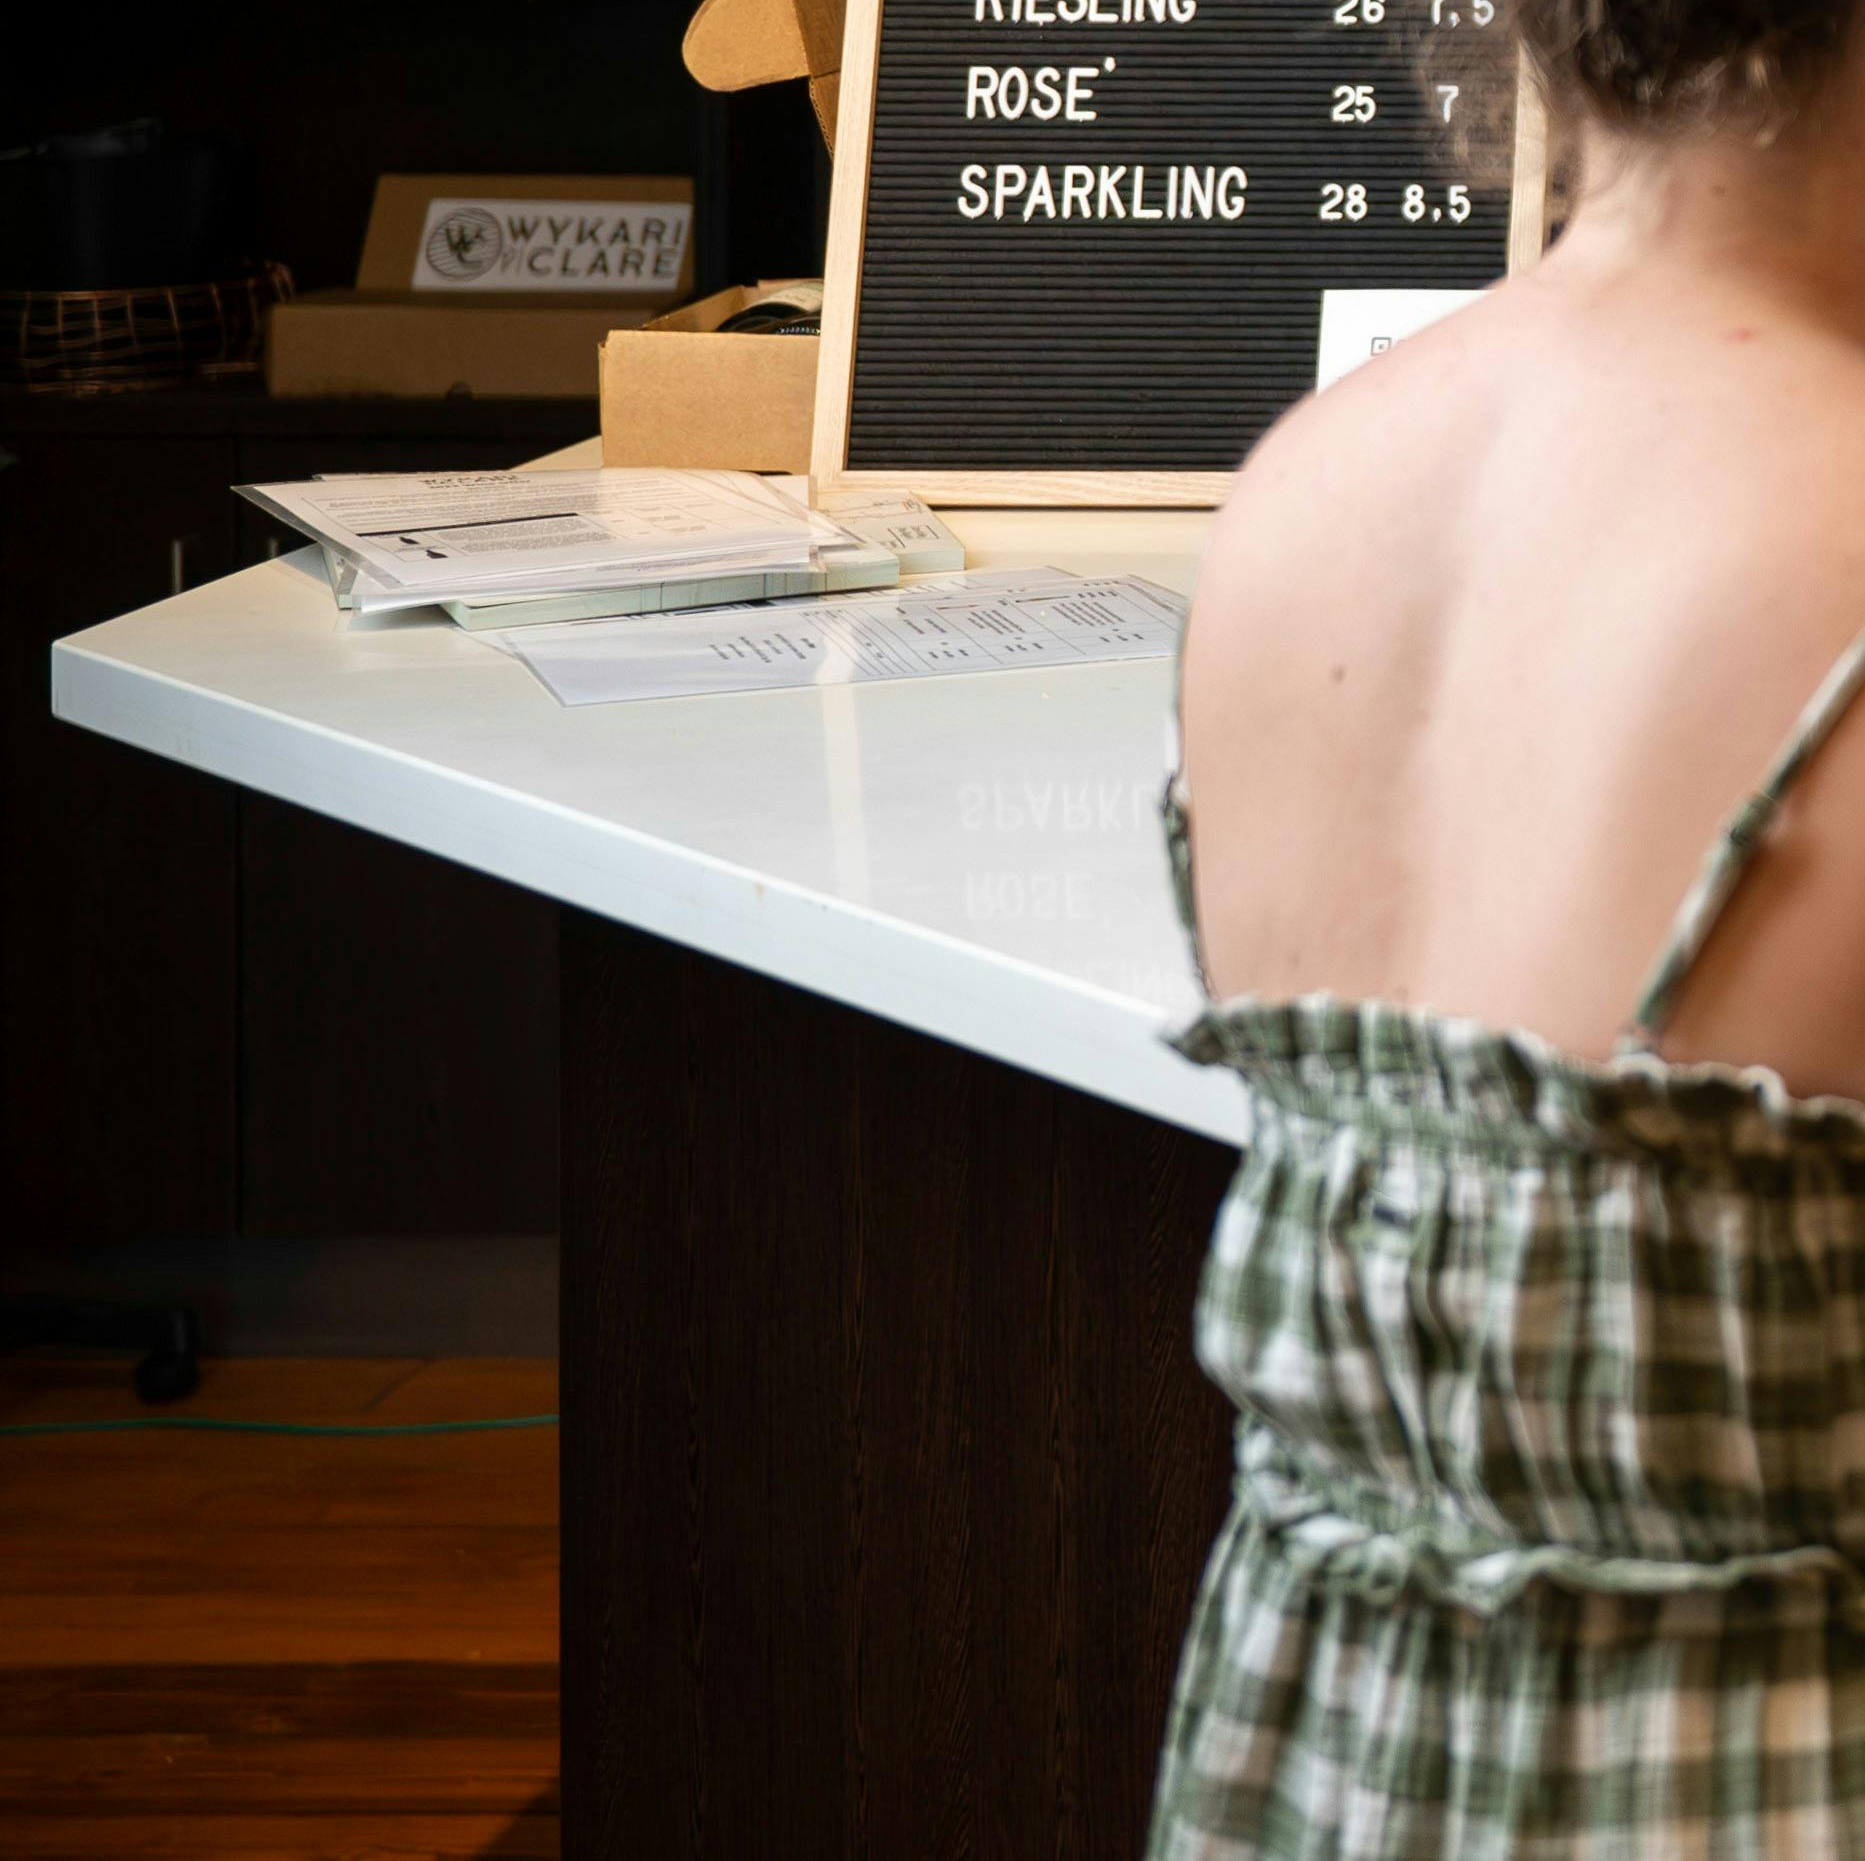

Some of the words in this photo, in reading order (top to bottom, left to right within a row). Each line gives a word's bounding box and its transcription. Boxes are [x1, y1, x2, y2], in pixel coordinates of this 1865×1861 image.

[1330, 84, 1376, 123] 25
[1435, 84, 1461, 123] 7
[956, 164, 1249, 221] SPARKLING
[1319, 182, 1369, 222] 28
[507, 217, 682, 245] WYKARI
[527, 245, 677, 277] CLARE
